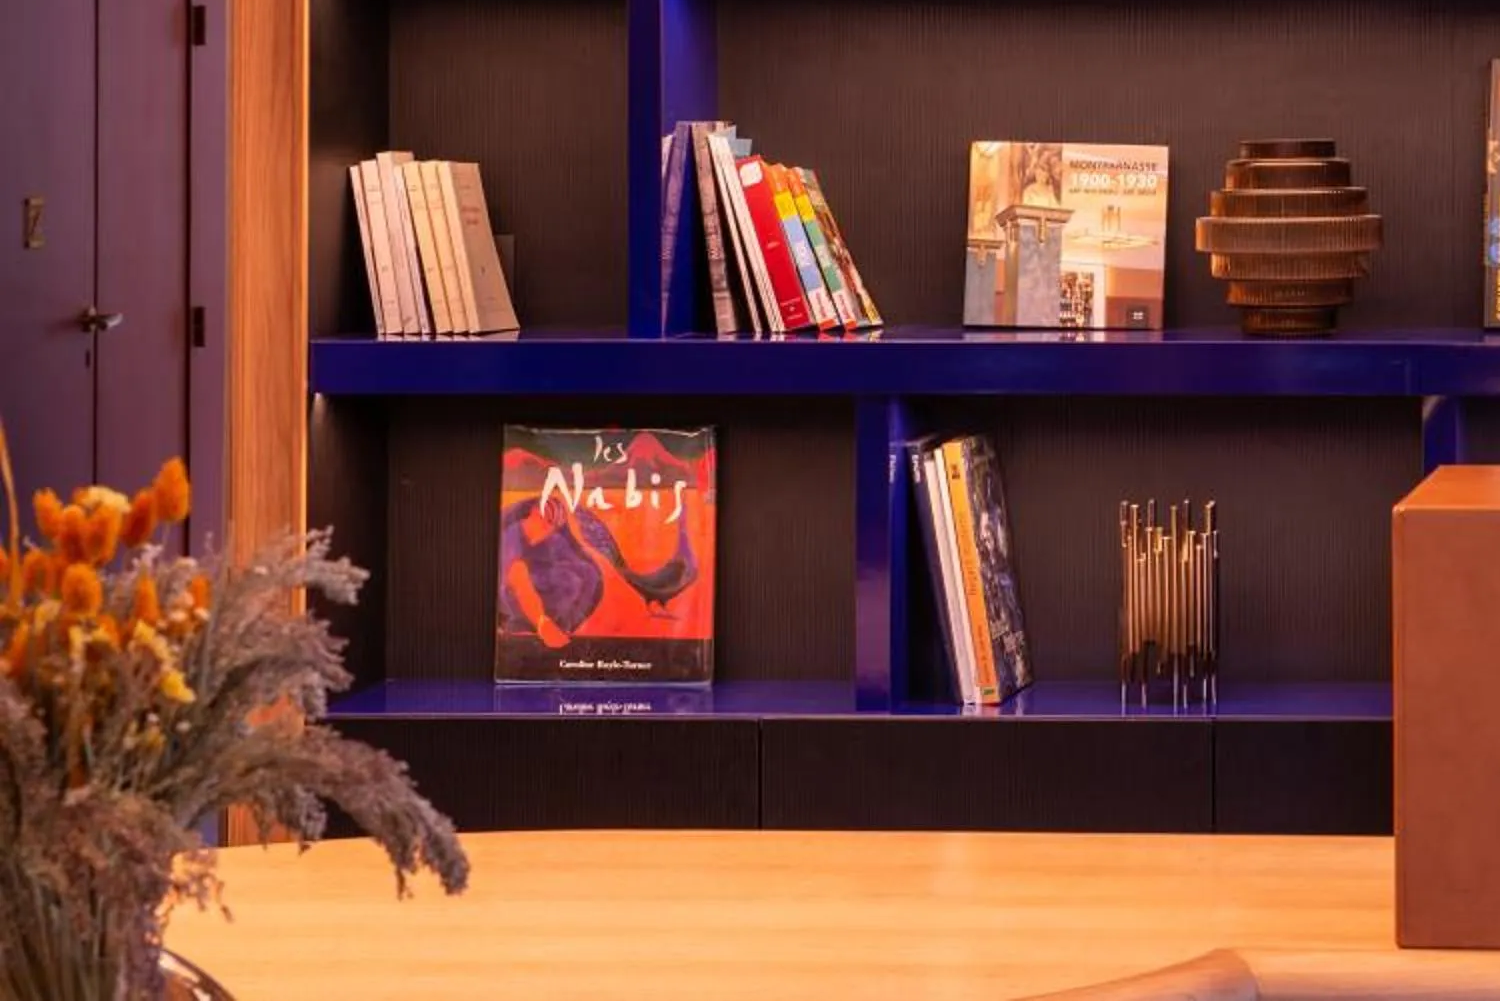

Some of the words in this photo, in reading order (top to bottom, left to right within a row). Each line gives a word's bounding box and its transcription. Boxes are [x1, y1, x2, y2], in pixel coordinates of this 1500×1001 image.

[1072, 172, 1157, 187] 1900-1930
[594, 435, 628, 463] les
[540, 462, 686, 524] Nabis
